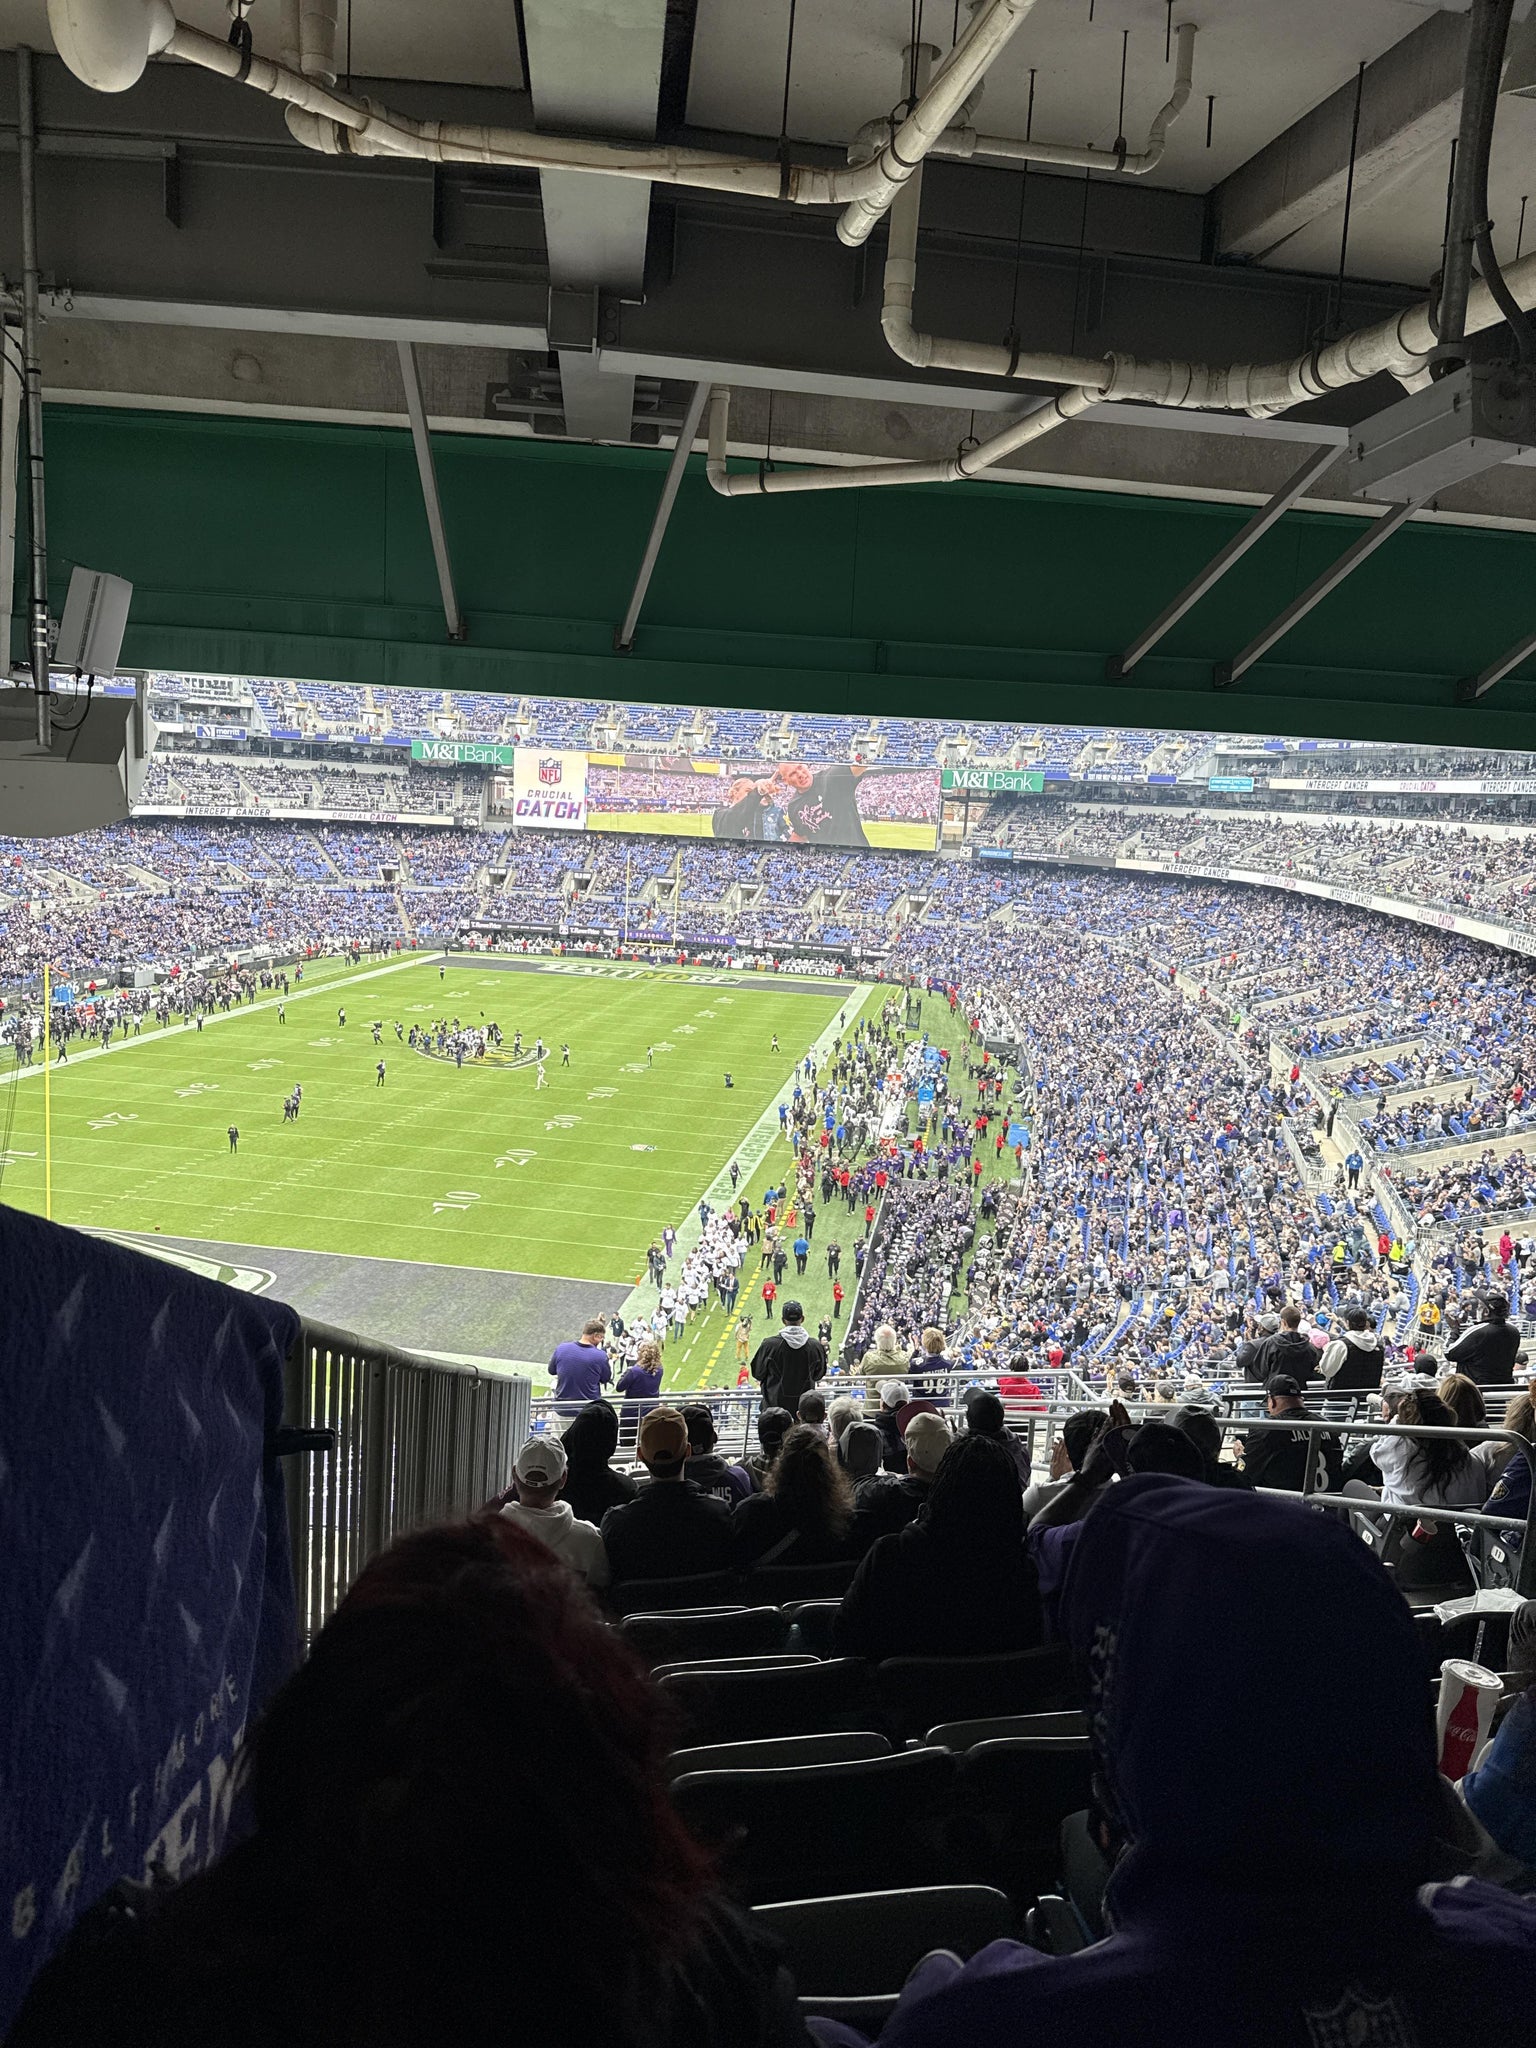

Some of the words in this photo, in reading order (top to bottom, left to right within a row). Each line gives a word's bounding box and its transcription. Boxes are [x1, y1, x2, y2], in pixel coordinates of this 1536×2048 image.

[422, 742, 463, 760] M&T
[465, 744, 503, 763] Bank
[541, 768, 560, 781] NFL
[952, 771, 992, 788] M&T
[993, 772, 1033, 791] Bank
[1306, 781, 1342, 790] INTERCEPT
[1344, 781, 1369, 790] CANCER
[1480, 781, 1512, 792] INTERCEPT
[527, 789, 573, 800] CRUCIAL
[185, 807, 232, 815] INTERCEPT
[235, 808, 271, 817] CANCER
[332, 811, 367, 820] CRUCIAL
[369, 813, 398, 822] CATCH
[516, 799, 583, 820] CATCH
[1162, 863, 1201, 875] INTERCEPT
[1203, 867, 1230, 878] CANCER
[1438, 914, 1456, 929] CATCH
[536, 963, 743, 985] BALTIMORE
[778, 964, 836, 977] MARYLAND
[86, 1111, 139, 1128] 20
[543, 1114, 583, 1128] 30
[493, 1148, 538, 1166] 20
[432, 1191, 482, 1211] 10
